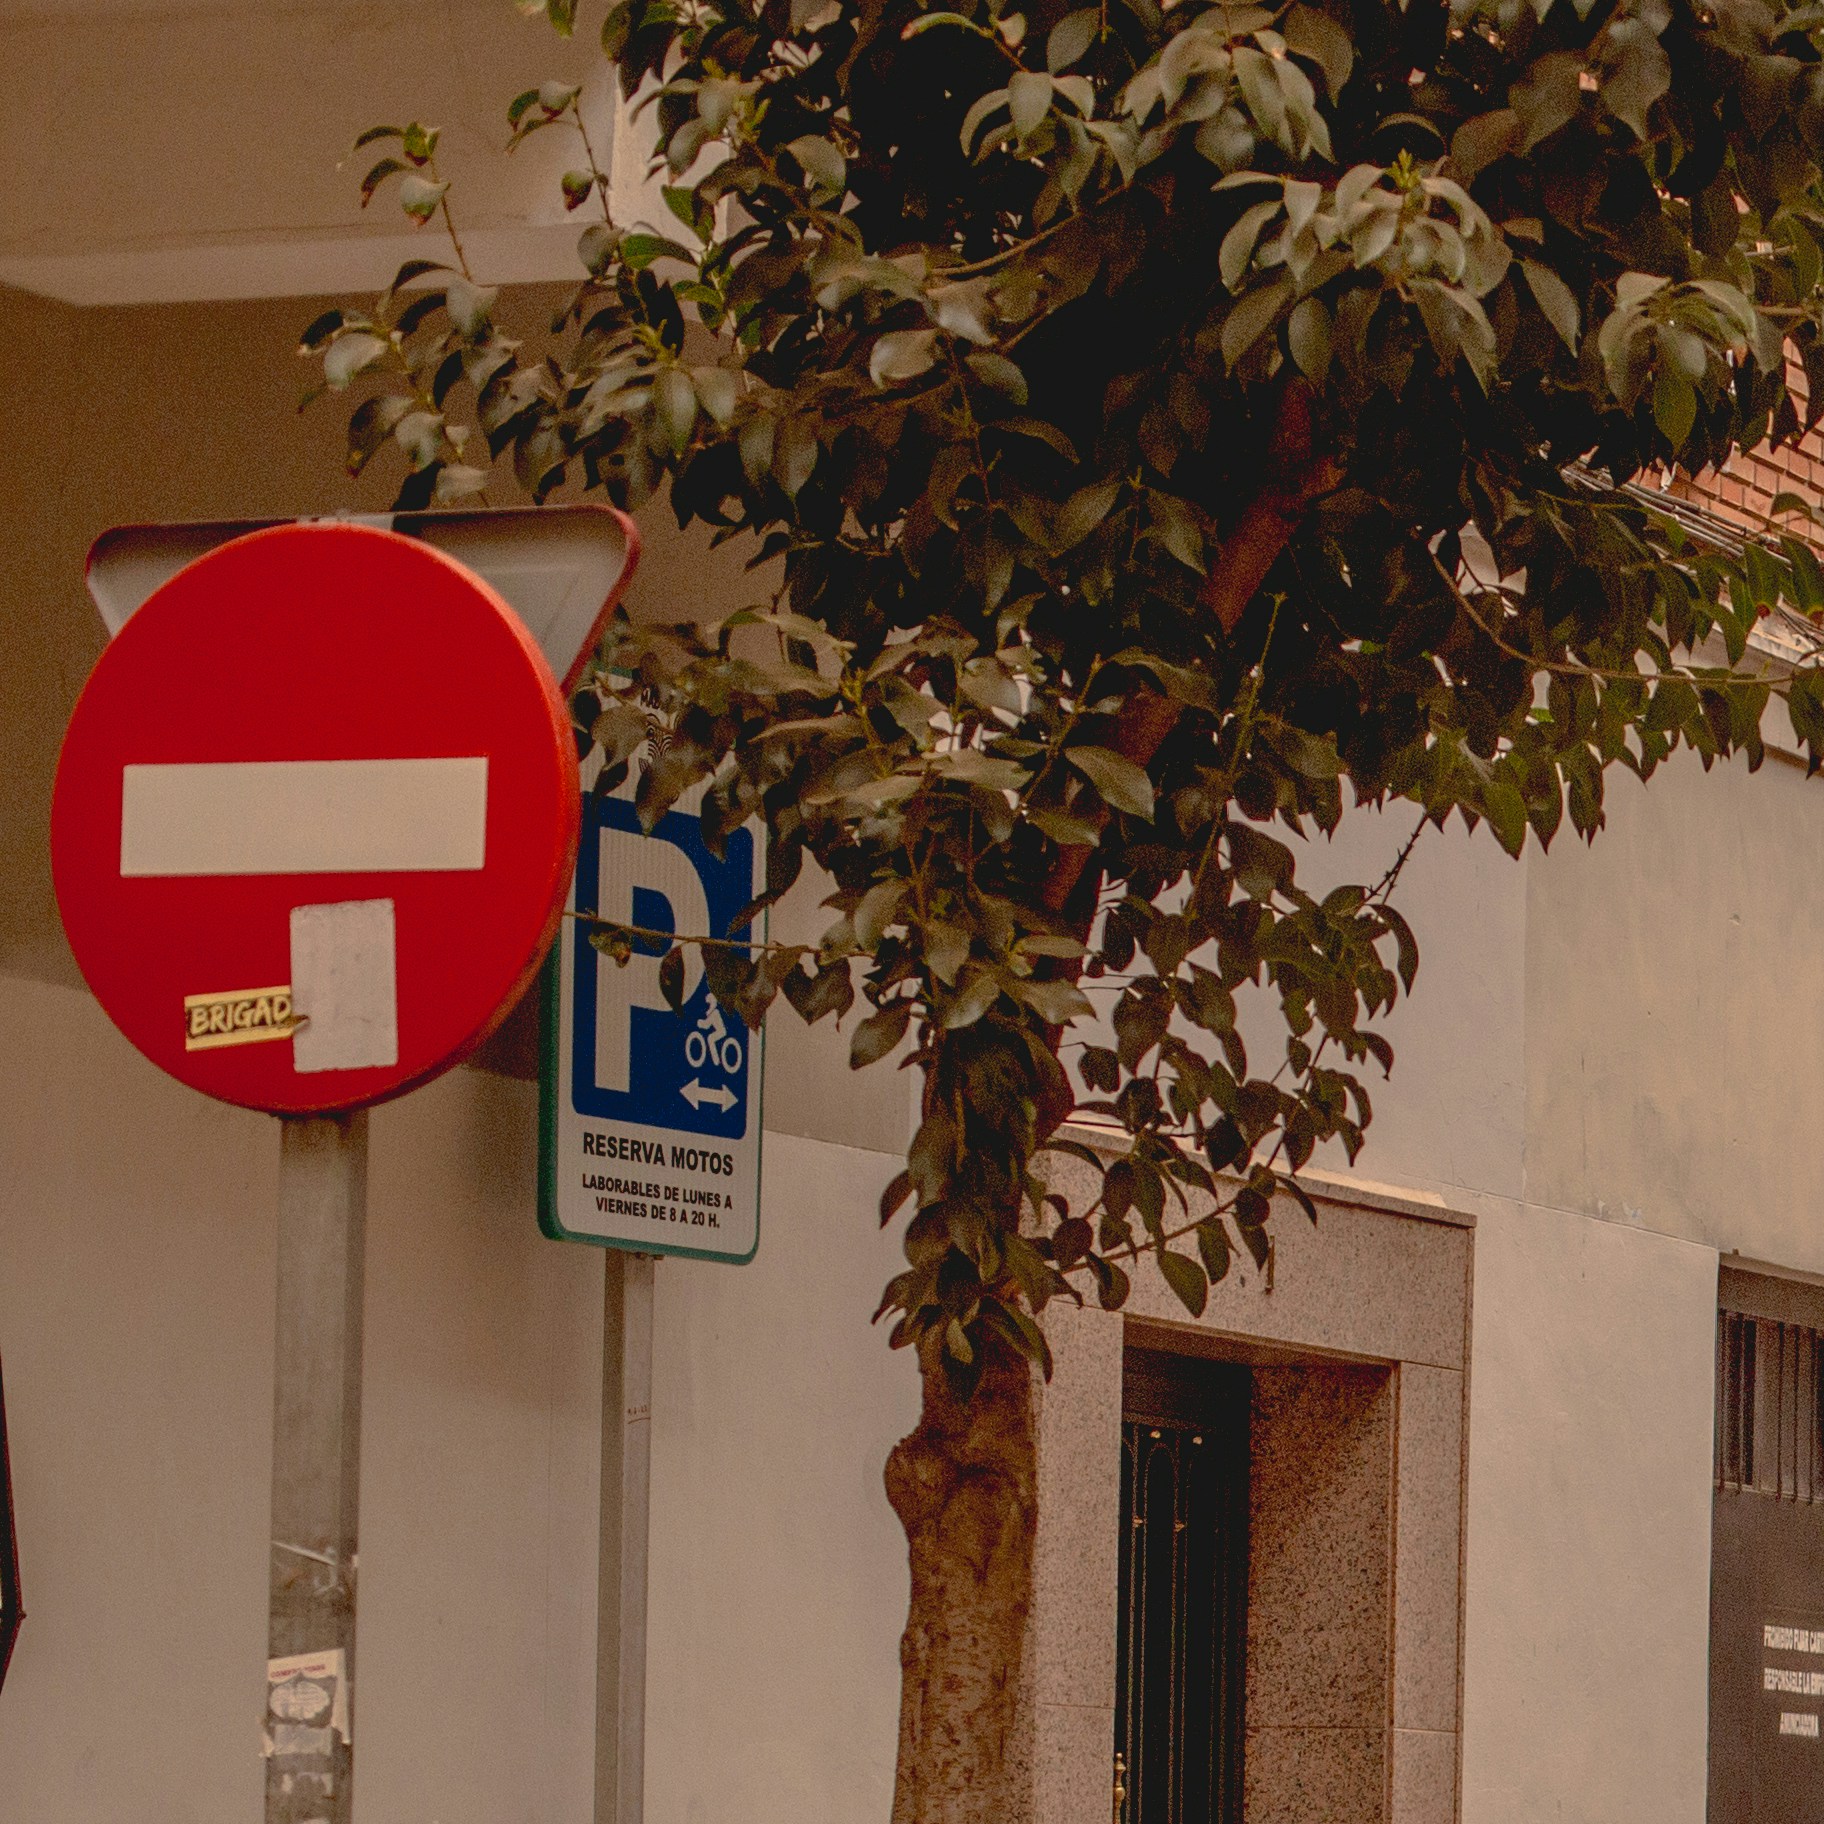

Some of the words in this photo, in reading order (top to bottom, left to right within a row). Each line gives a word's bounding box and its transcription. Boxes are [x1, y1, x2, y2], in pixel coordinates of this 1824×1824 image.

[595, 826, 710, 1094] P
[190, 995, 292, 1037] BRIGAD
[583, 1132, 665, 1166] RESERVA
[671, 1146, 733, 1176] MOTOS
[582, 1173, 660, 1198] LABORABLES
[664, 1185, 679, 1202] DE
[683, 1189, 721, 1207] LUNES
[724, 1195, 733, 1210] A
[596, 1196, 647, 1218] VIERNES
[651, 1205, 666, 1220] DE
[669, 1208, 677, 1222] 8
[680, 1209, 688, 1224] A
[691, 1211, 704, 1226] 20
[708, 1213, 720, 1228] H.
